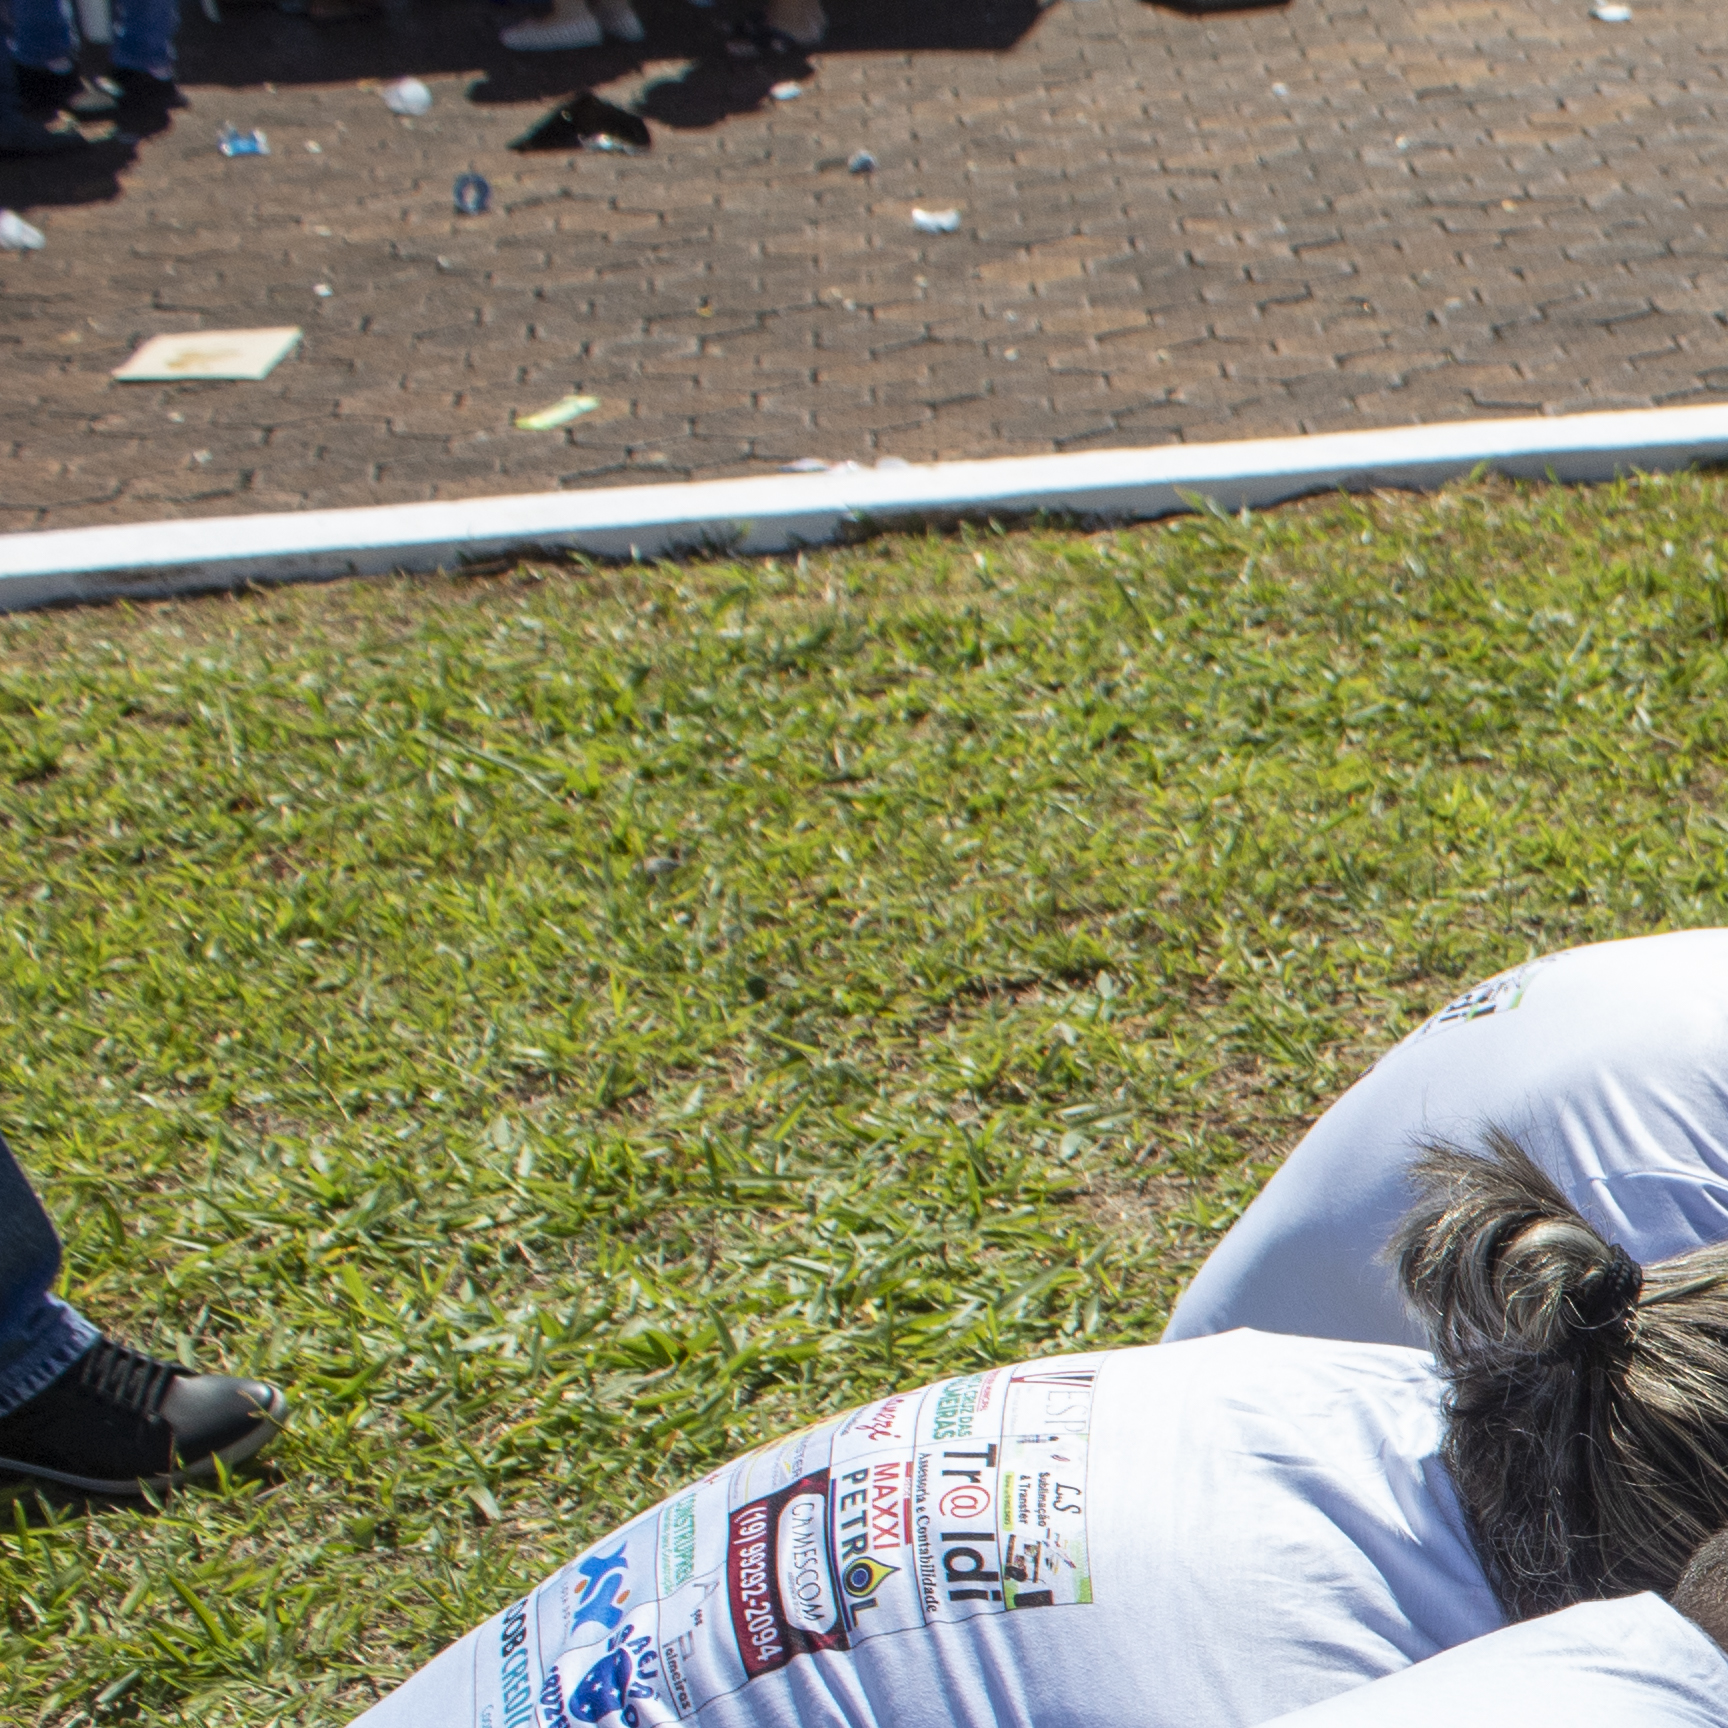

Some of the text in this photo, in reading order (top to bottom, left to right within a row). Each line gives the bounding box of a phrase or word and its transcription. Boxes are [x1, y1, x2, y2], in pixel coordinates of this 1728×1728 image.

[872, 1462, 901, 1550] MAXXI
[733, 1506, 783, 1662] (19) 99292-2094
[791, 1502, 826, 1621] CAMESCOM
[916, 1514, 940, 1613] Contabilidade
